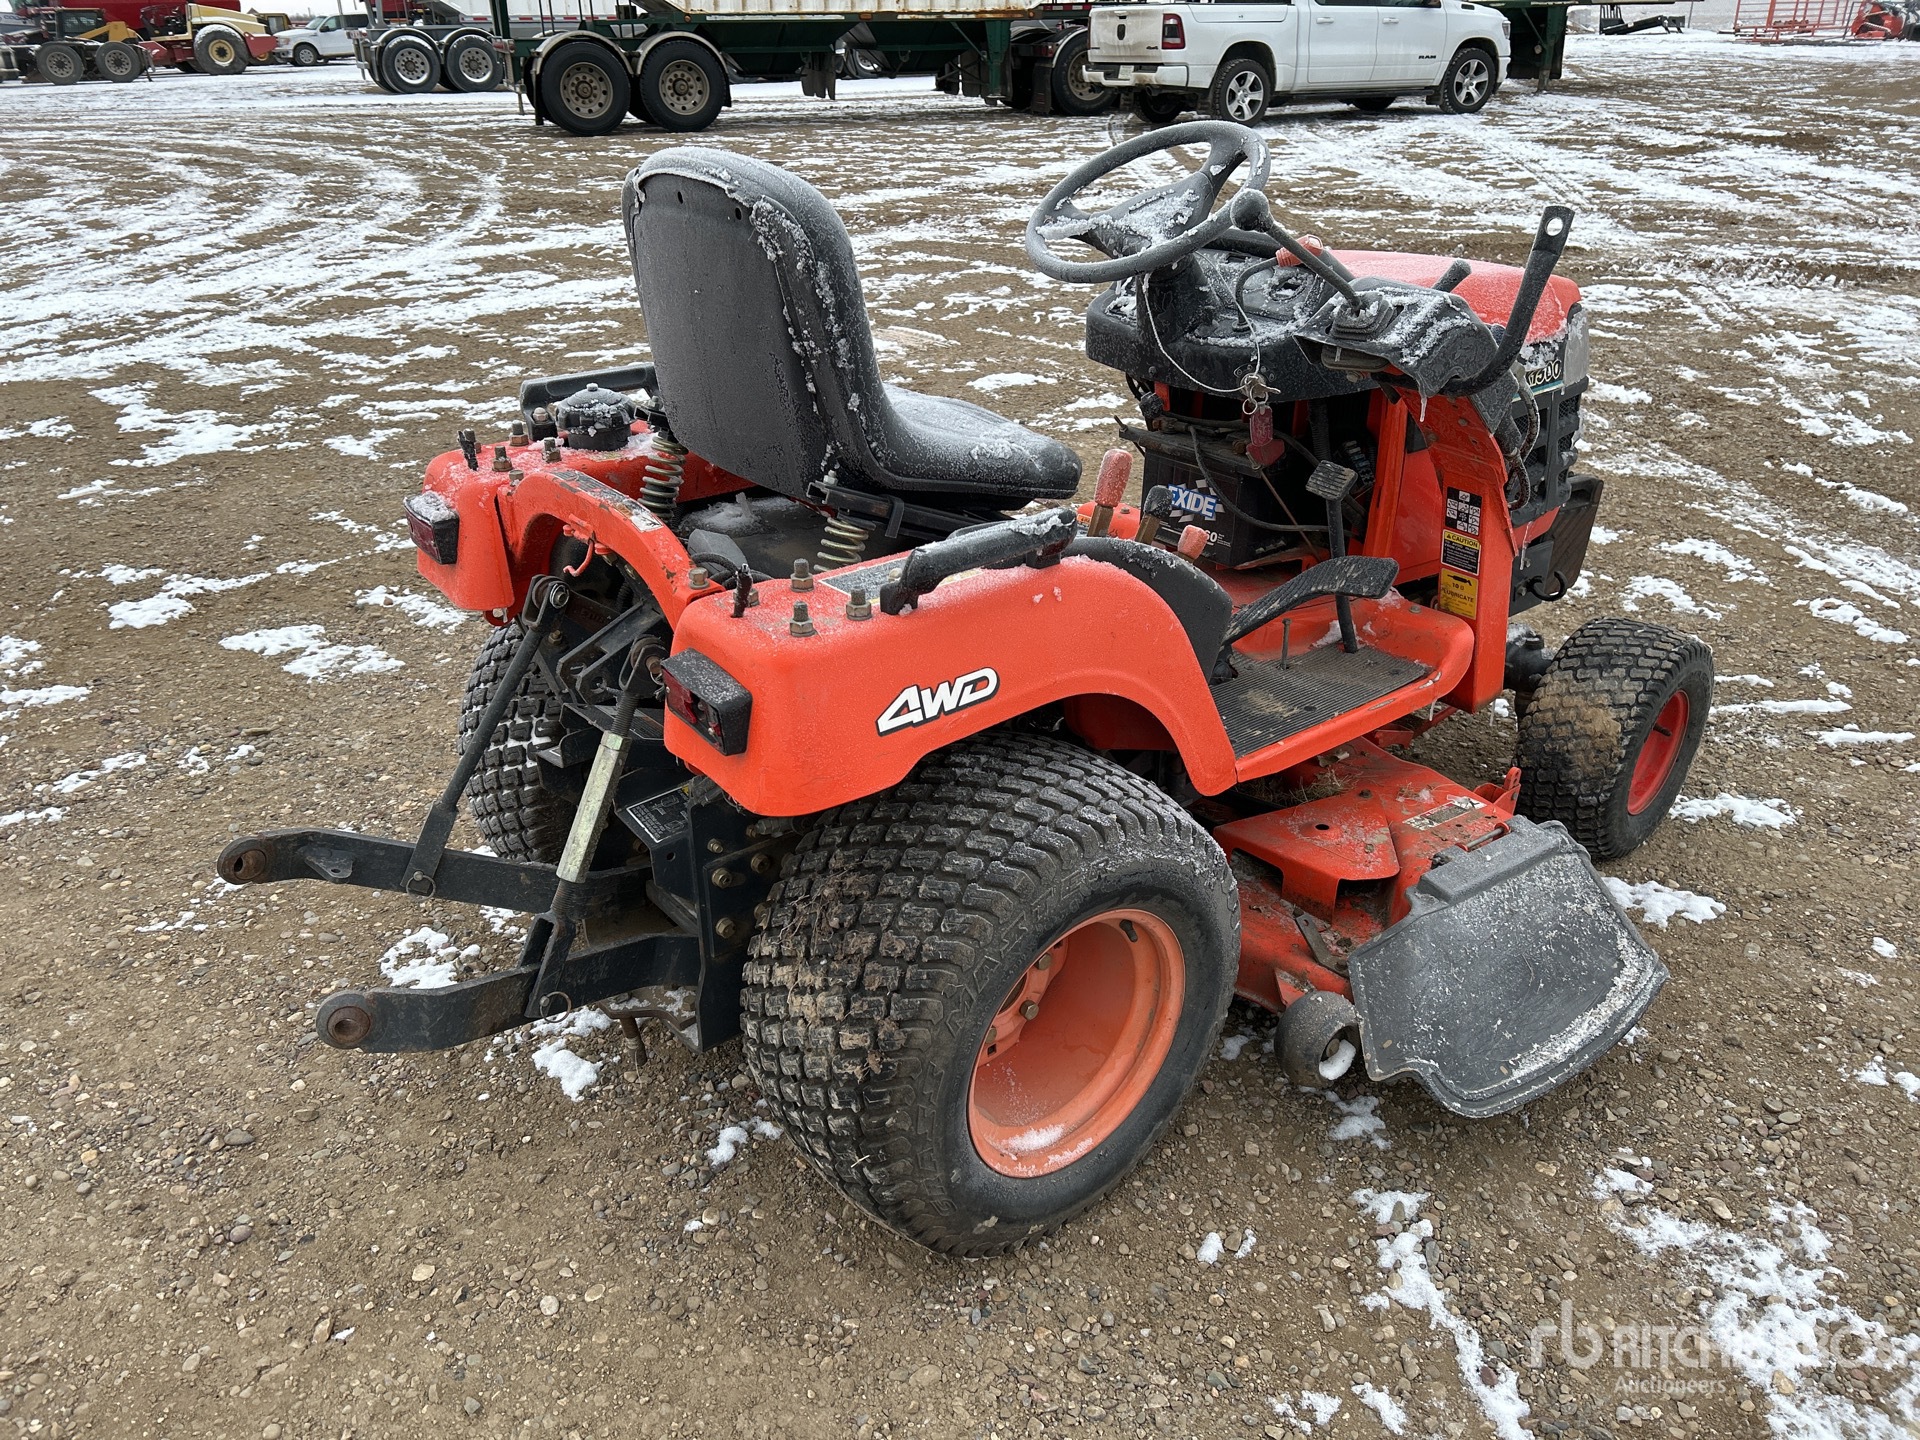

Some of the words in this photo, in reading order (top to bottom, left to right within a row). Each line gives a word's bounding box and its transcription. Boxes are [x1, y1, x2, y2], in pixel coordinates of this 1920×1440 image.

[1168, 485, 1216, 517] EXIDE
[1452, 535, 1478, 548] CAUTION
[876, 666, 999, 736] 4WD
